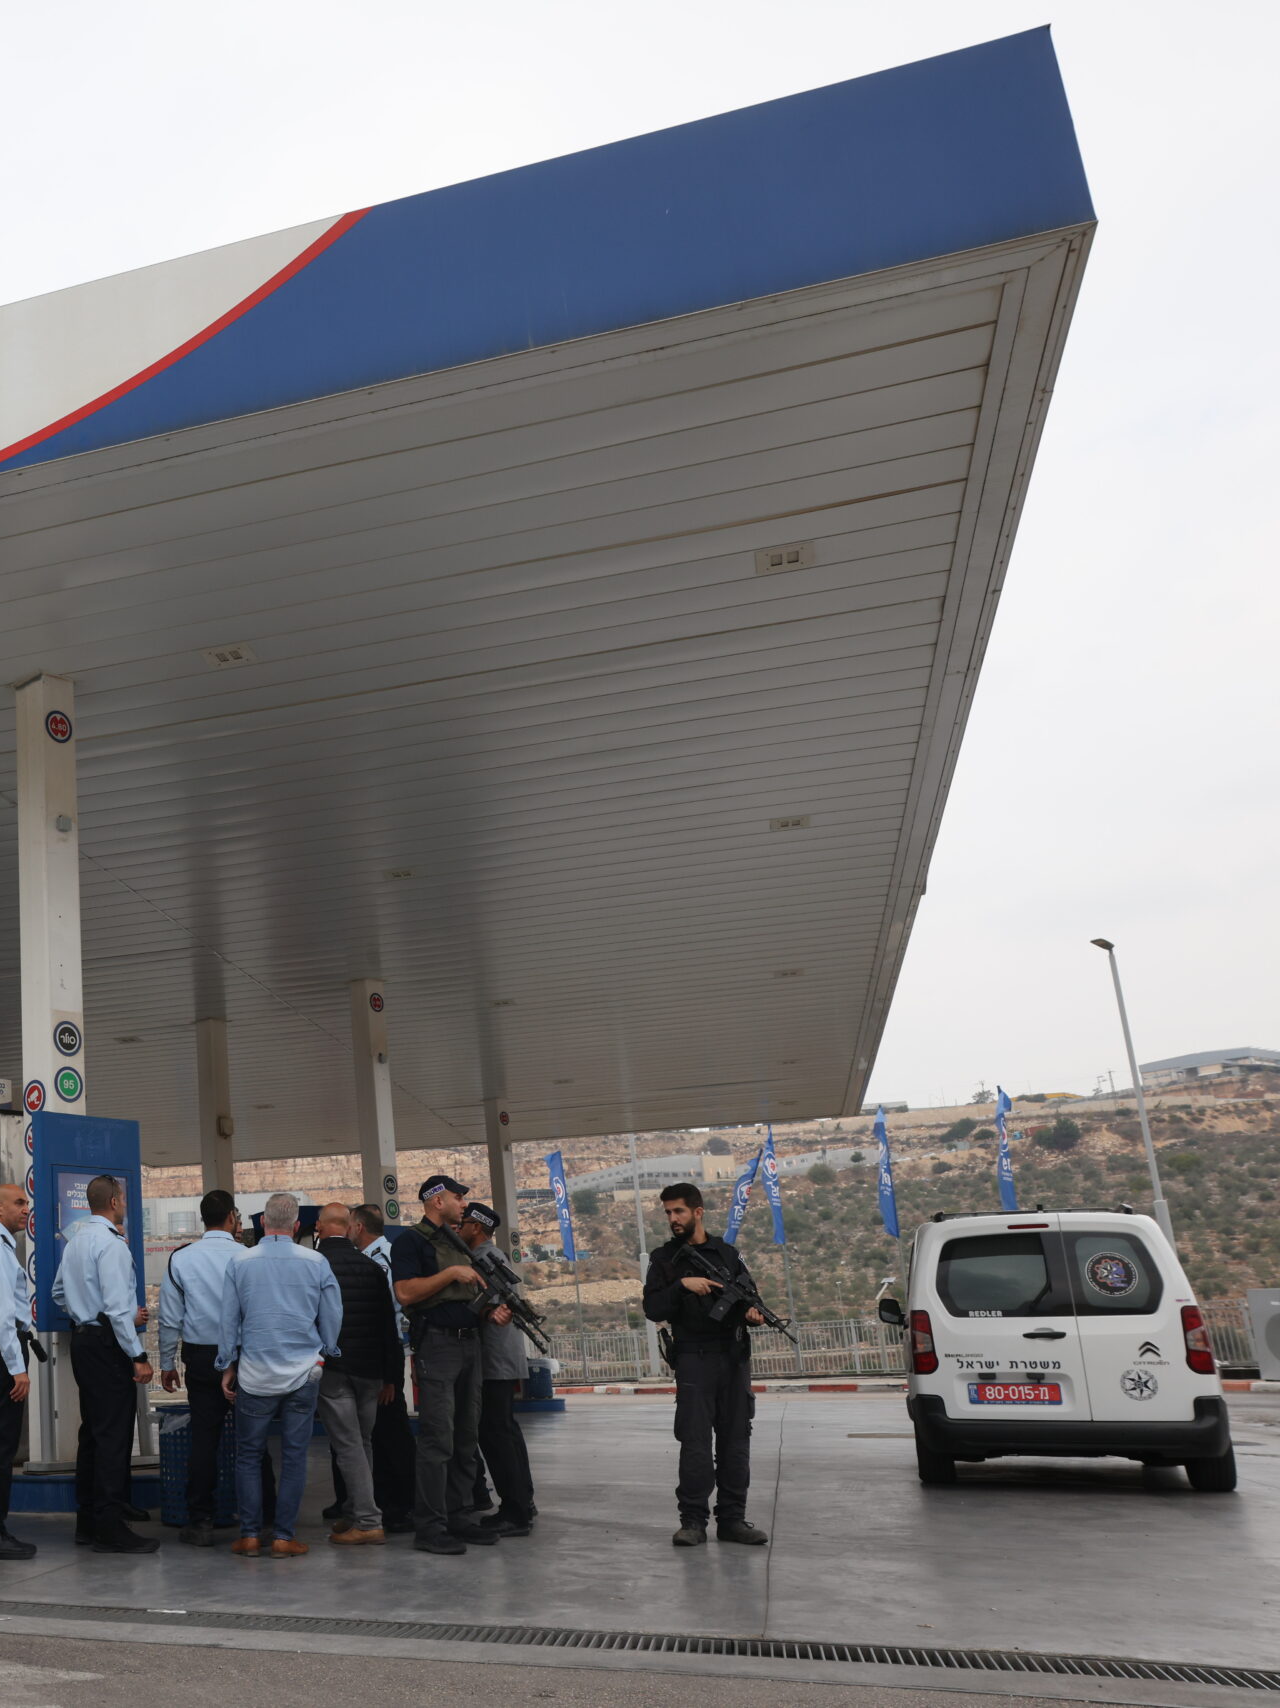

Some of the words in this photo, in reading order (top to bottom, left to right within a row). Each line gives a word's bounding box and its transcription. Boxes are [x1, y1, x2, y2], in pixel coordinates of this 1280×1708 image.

[60, 1032, 76, 1045] סולר
[63, 1079, 75, 1090] 95
[968, 1310, 1003, 1318] REDLER
[956, 1358, 1000, 1369] ישראל
[1009, 1360, 1061, 1369] משטרת
